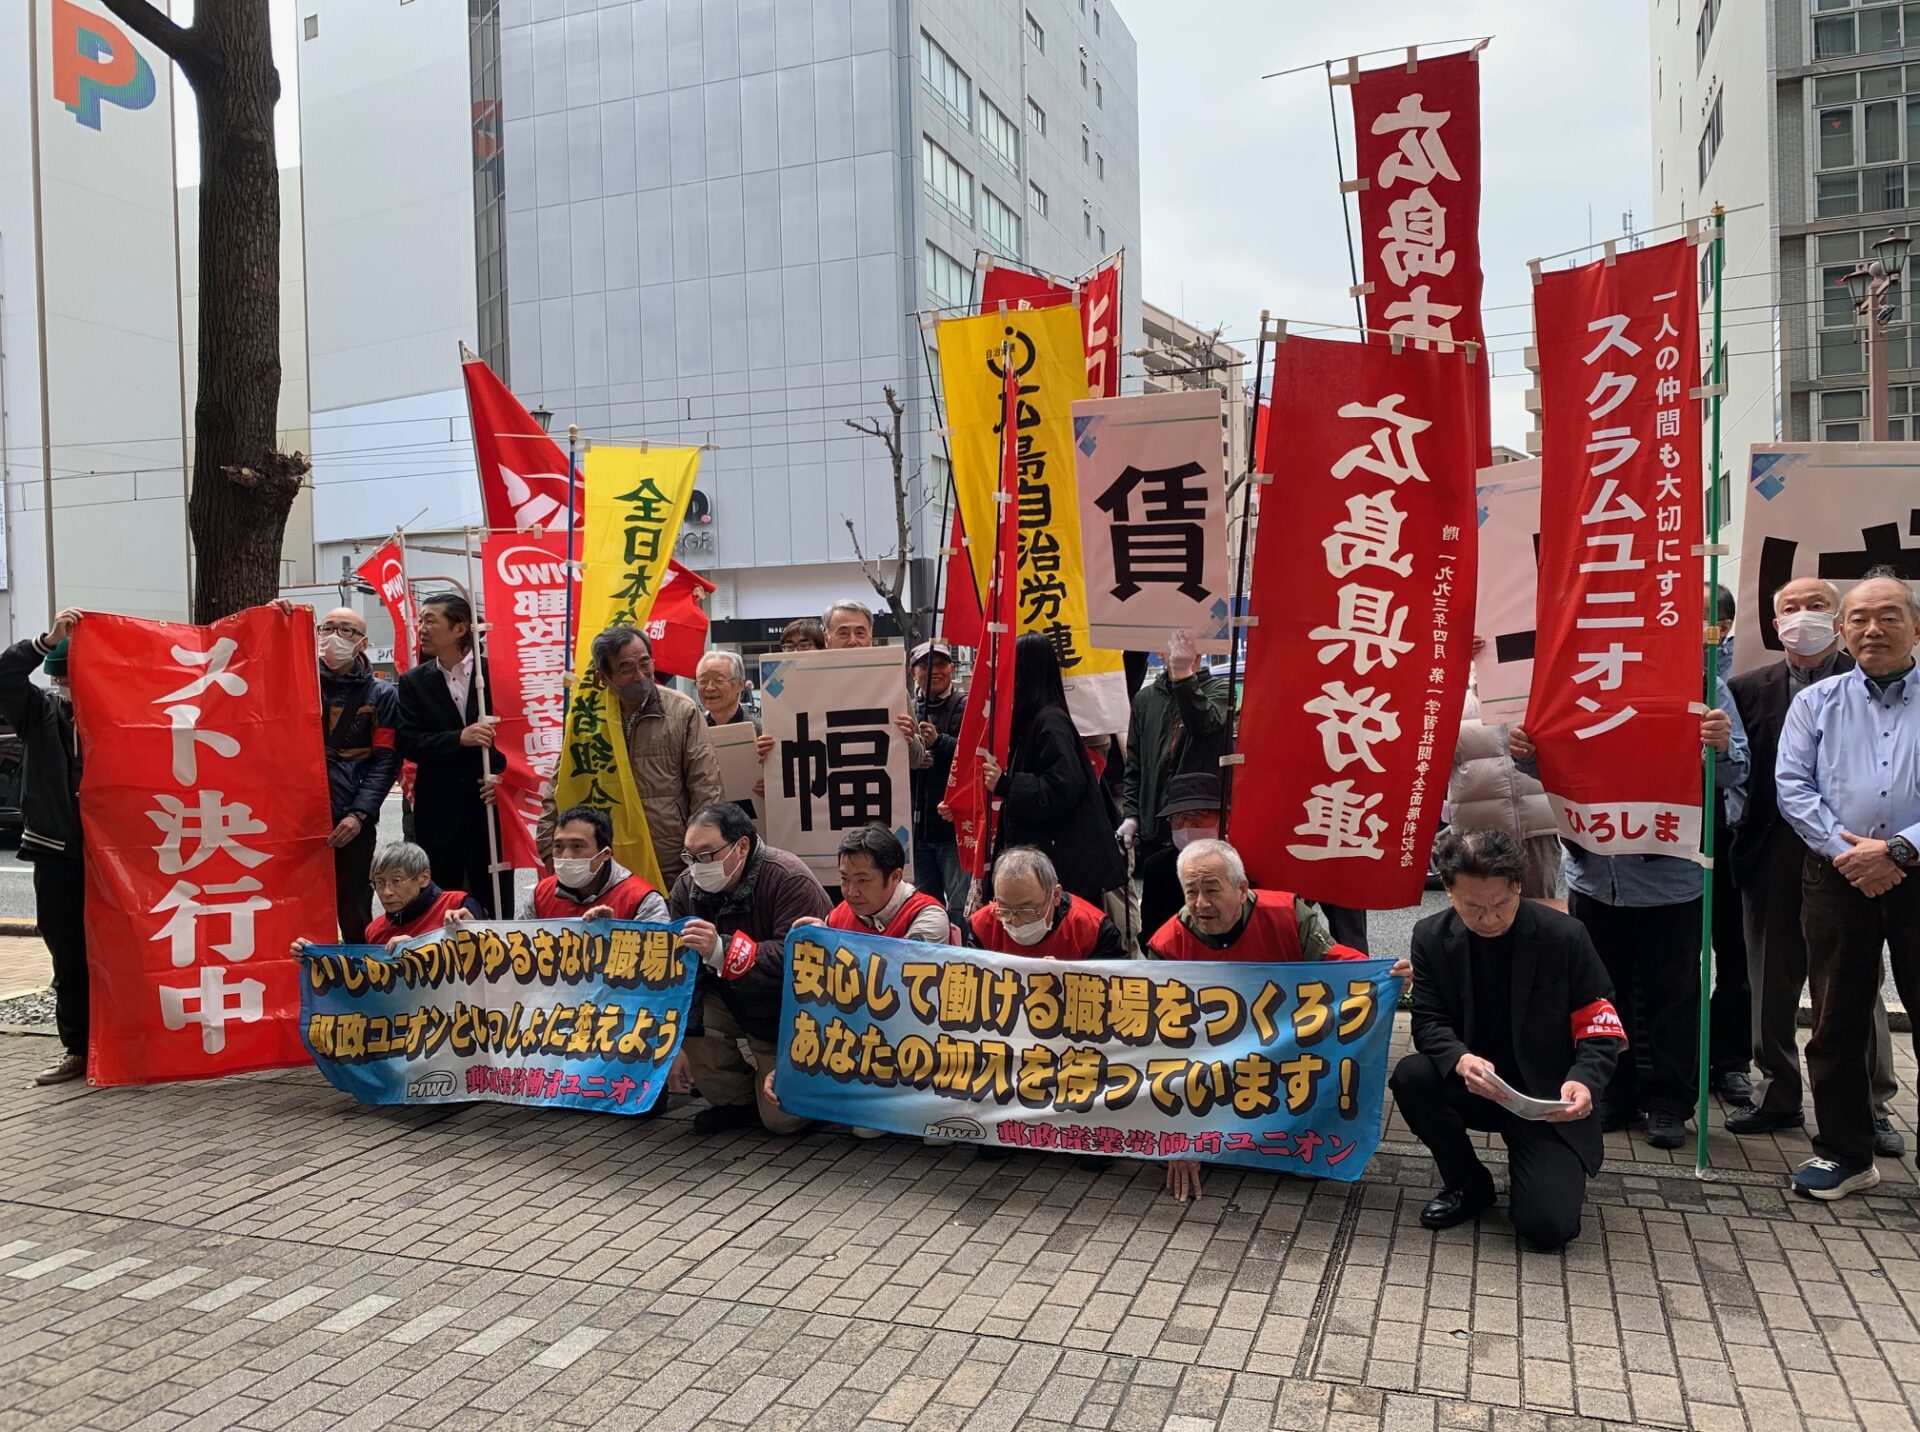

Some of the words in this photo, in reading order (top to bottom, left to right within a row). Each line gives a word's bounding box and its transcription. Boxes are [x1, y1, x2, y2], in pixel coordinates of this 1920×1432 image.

[1652, 292, 1682, 627] 一人の仲間も大切にする
[674, 531, 713, 551] GE
[1094, 461, 1213, 602] 賃
[1571, 313, 1646, 740] スクラムユニオン
[382, 559, 405, 602] PIW
[781, 708, 892, 832] 幅
[145, 637, 273, 1054] スト決行中
[1564, 806, 1680, 843] ひろしま
[792, 940, 1380, 1046] 安心して働ける職場をつくろう
[407, 1070, 457, 1097] PIWU
[923, 1117, 987, 1141] PIWU
